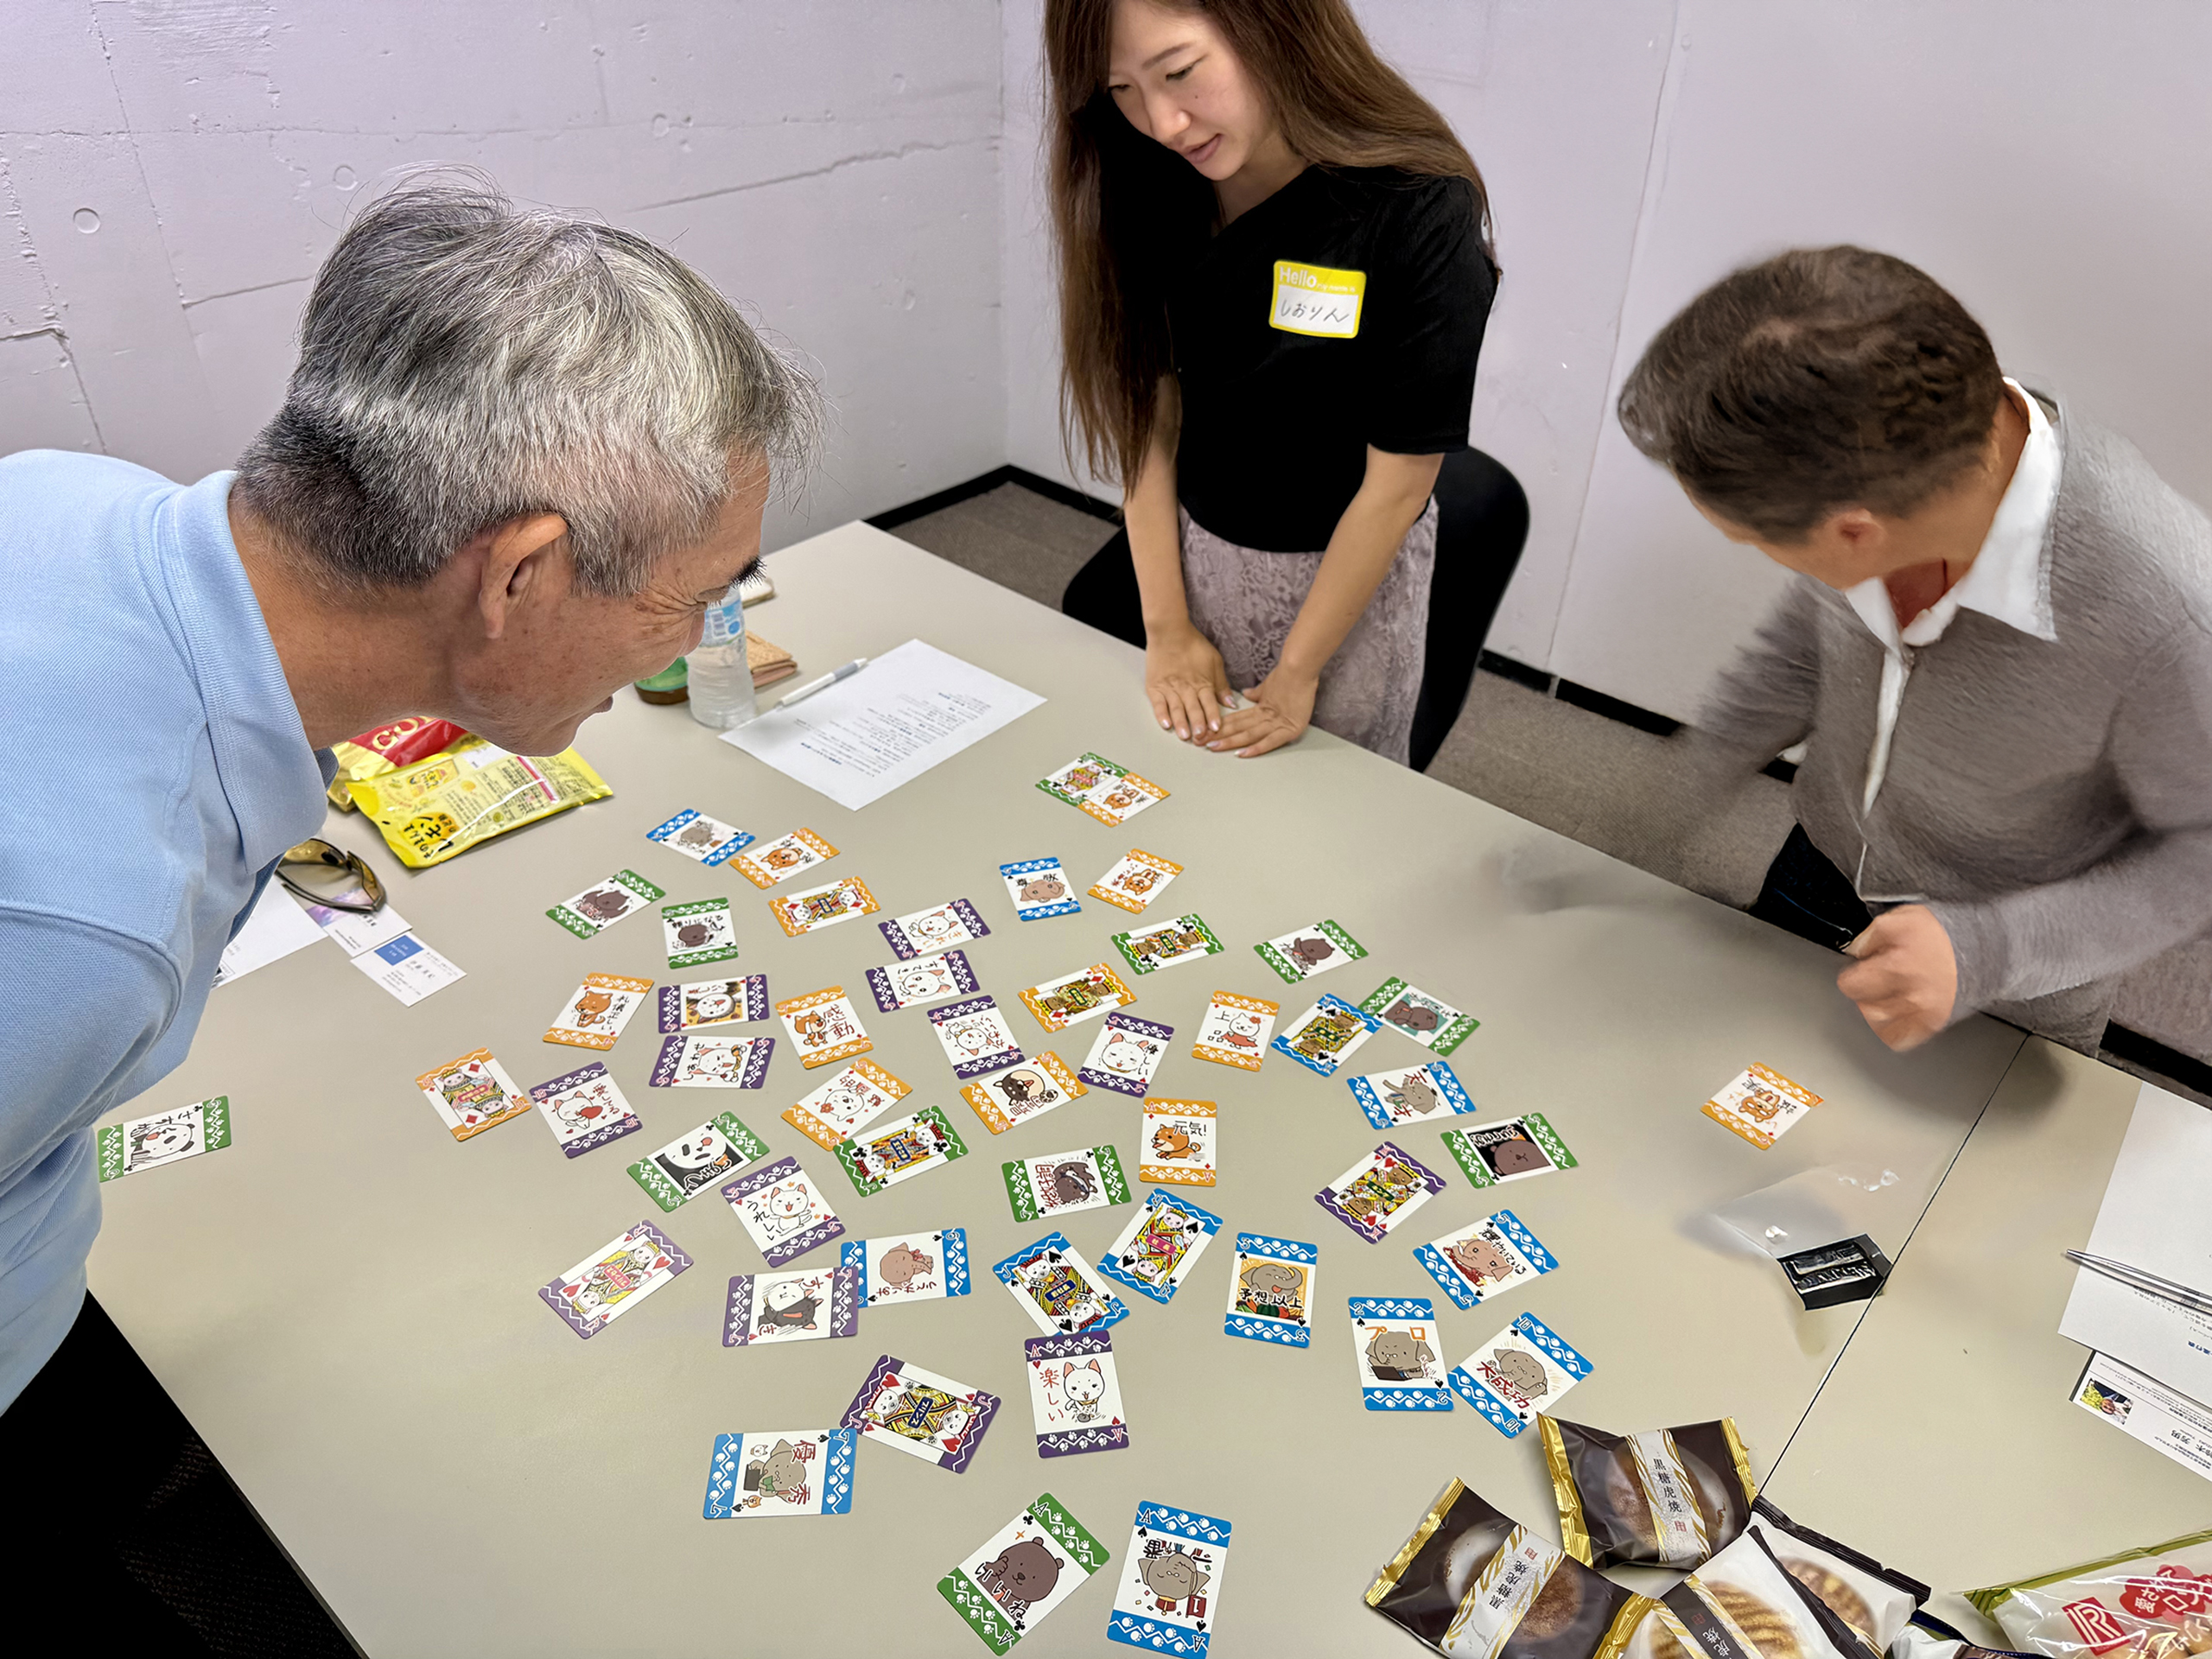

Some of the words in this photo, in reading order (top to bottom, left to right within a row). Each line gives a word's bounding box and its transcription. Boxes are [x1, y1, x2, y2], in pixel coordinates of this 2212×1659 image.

[1279, 266, 1317, 288] Hello
[1281, 300, 1349, 323] しおりん
[372, 715, 435, 750] GO
[923, 931, 963, 947] きれい
[896, 961, 939, 976] すてき
[823, 1006, 855, 1040] 感動
[1208, 1010, 1230, 1043] 上品
[683, 1042, 705, 1080] しあわせ
[593, 1083, 620, 1114] 愛してる
[1009, 1095, 1046, 1117] 最高
[1147, 1100, 1156, 1110] A
[137, 1109, 192, 1133] さすが
[1034, 1163, 1064, 1208] 絶好調
[1203, 1172, 1211, 1183] A
[1150, 1192, 1164, 1205] Q
[747, 1200, 782, 1241] うれしい
[1495, 1211, 1510, 1223] 5
[944, 1231, 958, 1240] 6
[1241, 1237, 1249, 1249] 3
[603, 1265, 630, 1289] プリンセス
[838, 1268, 852, 1278] 7
[998, 1265, 1013, 1279] J
[875, 1280, 938, 1297] ありがとう
[1157, 1283, 1172, 1298] Q
[1239, 1287, 1303, 1309] 予想以上
[1458, 1293, 1475, 1305] 5
[1109, 1301, 1124, 1315] J
[1353, 1302, 1364, 1314] 2
[1516, 1317, 1533, 1330] 10
[728, 1332, 744, 1341] 7
[1295, 1328, 1306, 1342] 3
[1363, 1325, 1427, 1341] プロ
[1030, 1343, 1041, 1357] A
[1476, 1360, 1531, 1411] 大成功
[976, 1395, 995, 1408] J
[1039, 1368, 1064, 1421] 楽しい
[1436, 1391, 1448, 1404] 2
[910, 1399, 931, 1426] プリンス
[845, 1414, 864, 1429] J
[1503, 1416, 1521, 1433] 10
[833, 1432, 851, 1441] 7
[1111, 1427, 1124, 1443] A
[790, 1439, 817, 1505] 優秀
[1653, 1458, 1683, 1513] 黒糖虎焼
[710, 1503, 728, 1512] 7
[1033, 1499, 1051, 1516] A
[1140, 1506, 1154, 1523] A
[975, 1562, 1027, 1620] いいね
[1489, 1560, 1529, 1609] 黒糖虎焼
[993, 1629, 1014, 1649] A
[1189, 1635, 1204, 1654] A
[1702, 1626, 1732, 1659] 虎焼
